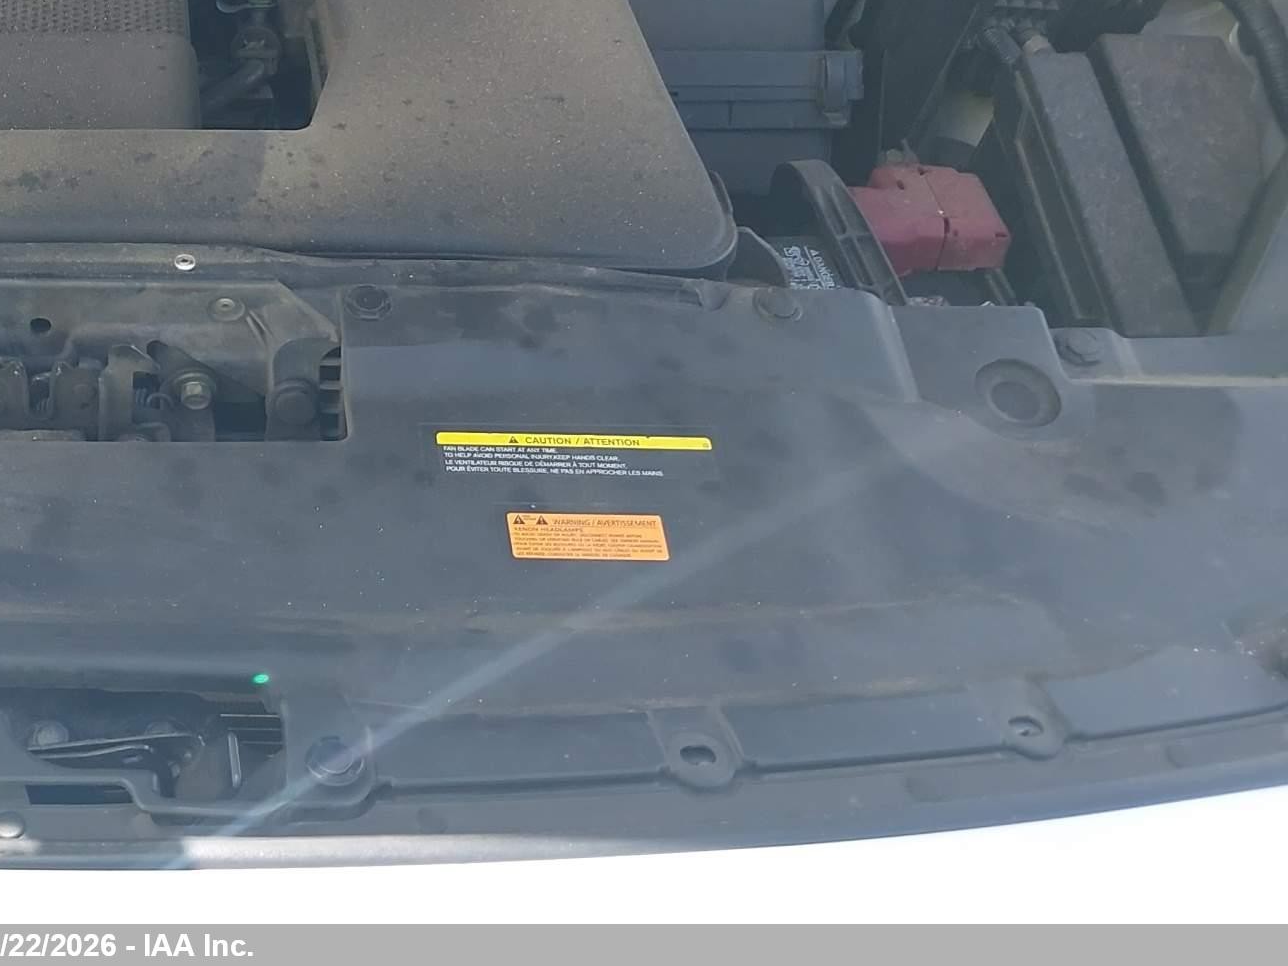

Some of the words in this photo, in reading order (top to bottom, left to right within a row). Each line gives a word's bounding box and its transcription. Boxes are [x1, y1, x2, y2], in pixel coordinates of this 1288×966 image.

[525, 436, 572, 444] CAUTION
[583, 437, 640, 446] ATTENTION
[466, 465, 489, 473] ÉVITER
